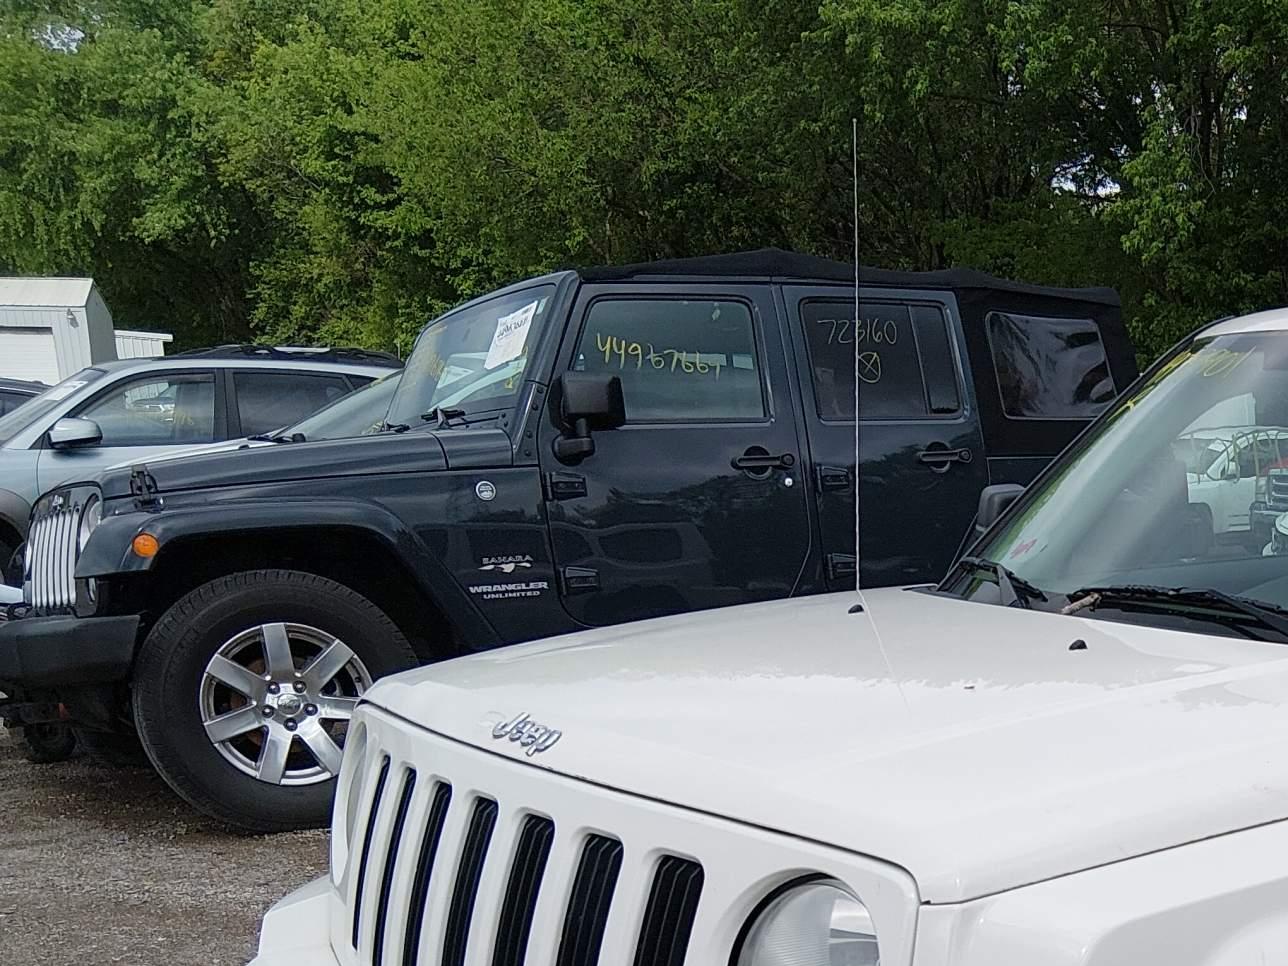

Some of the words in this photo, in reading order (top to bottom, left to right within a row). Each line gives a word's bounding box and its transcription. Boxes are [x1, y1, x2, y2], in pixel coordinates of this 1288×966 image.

[816, 318, 897, 345] 723160
[468, 582, 549, 593] WRANGLER
[483, 591, 540, 599] UNLIMITED
[492, 712, 562, 757] Jeep
